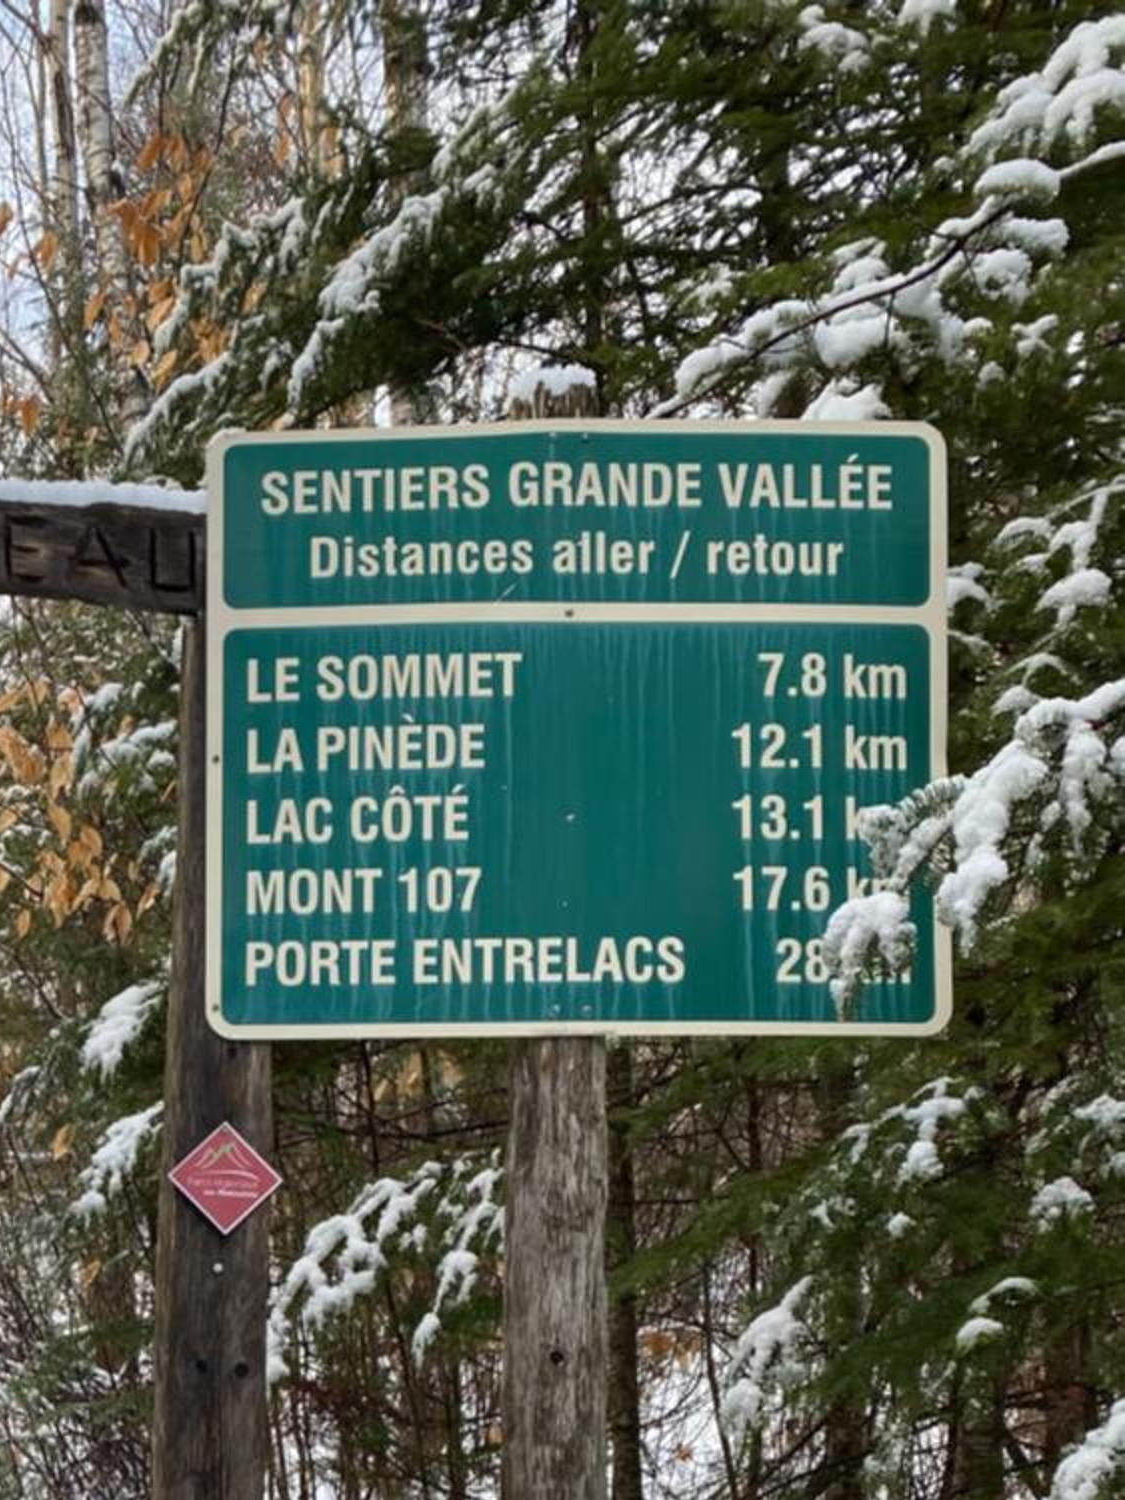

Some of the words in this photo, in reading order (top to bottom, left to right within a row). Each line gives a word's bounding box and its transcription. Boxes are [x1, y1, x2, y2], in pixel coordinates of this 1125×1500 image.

[262, 464, 490, 515] SENTIERS
[509, 462, 701, 508] GRANDE
[718, 454, 892, 510] VALLÉE
[311, 536, 533, 578] Distances
[553, 531, 655, 574] aller
[670, 531, 690, 578] /
[707, 534, 844, 576] retour
[247, 657, 300, 703] LE
[316, 652, 523, 701] SOMMET
[758, 652, 827, 697] 7.8
[844, 654, 906, 699] km
[247, 728, 303, 774] LA
[317, 714, 485, 771] PINÈDE
[731, 723, 822, 769] 12.1
[845, 725, 907, 771] km
[247, 797, 332, 844] LAC
[350, 784, 469, 843] CÔTÉ
[732, 794, 823, 840] 13.1
[246, 868, 383, 915] MONT
[398, 866, 482, 913] 107
[732, 865, 831, 912] 17.6
[245, 939, 396, 986] PORTE
[413, 936, 685, 984] ENTRELACS
[775, 937, 830, 984] 28
